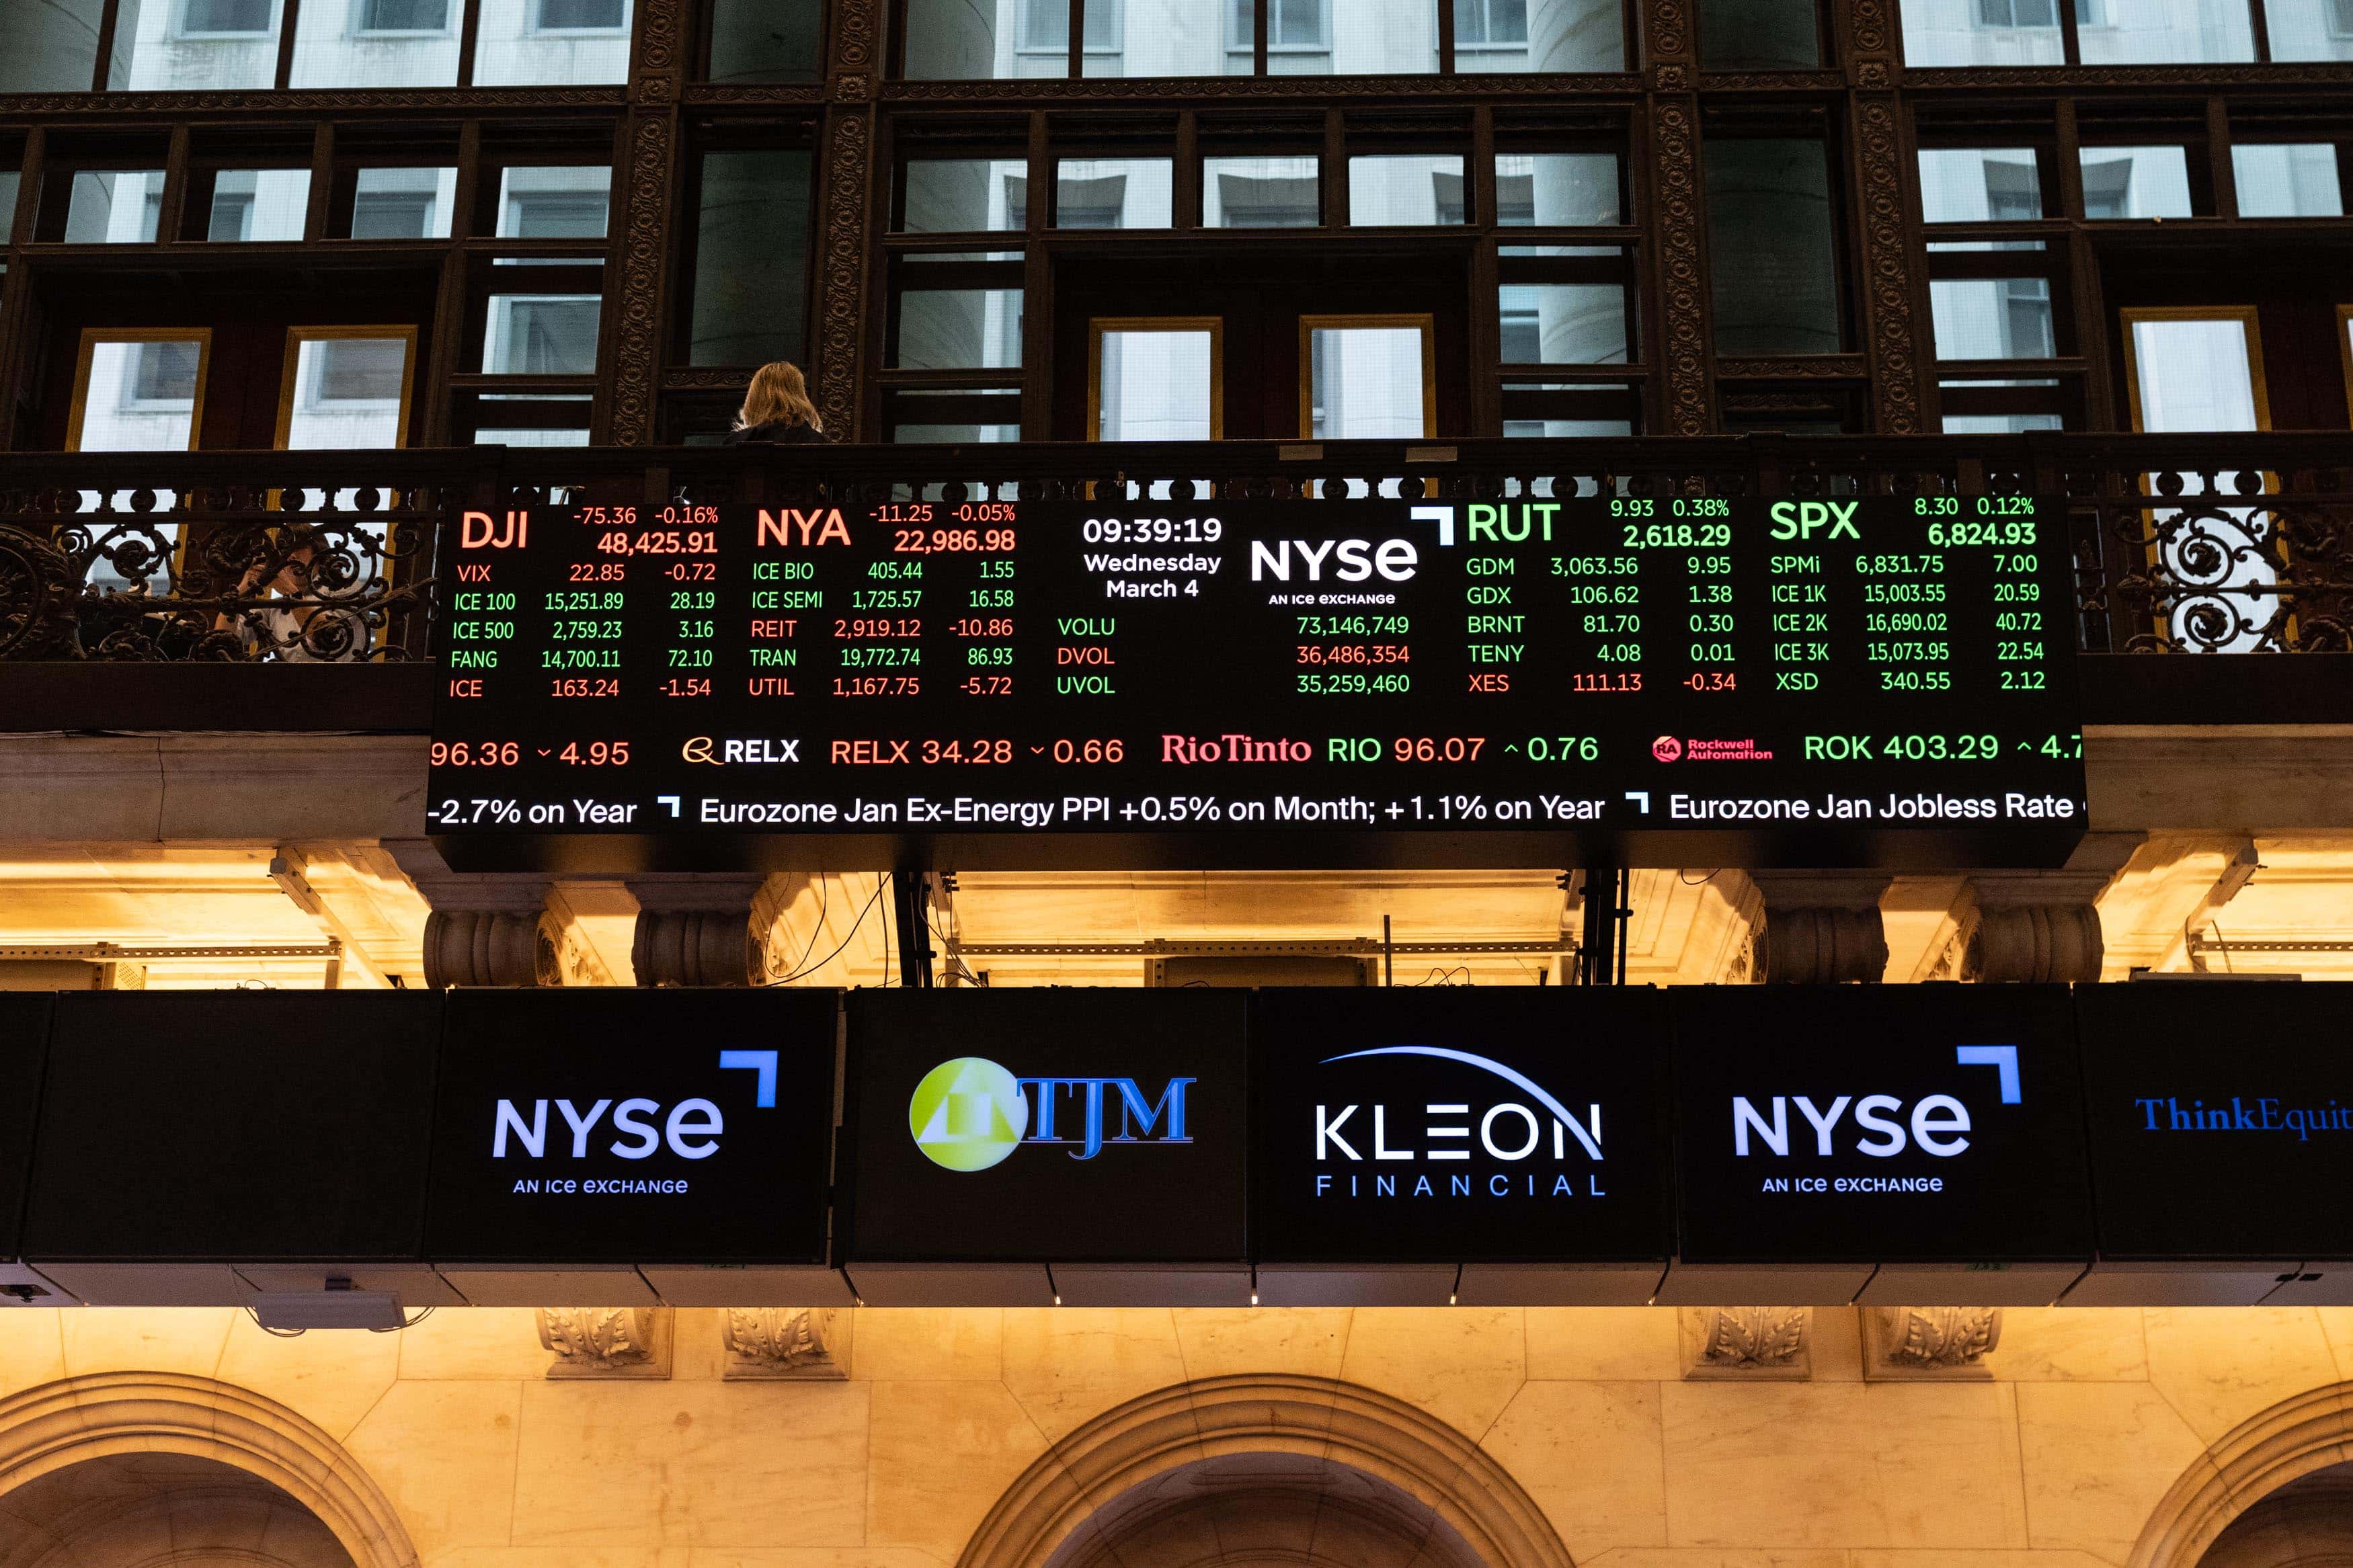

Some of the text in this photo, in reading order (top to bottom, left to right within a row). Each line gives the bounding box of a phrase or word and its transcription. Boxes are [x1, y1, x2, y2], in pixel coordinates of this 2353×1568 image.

[574, 507, 718, 524] -75.36 -0.16%
[870, 504, 1015, 522] -11.25 -0.05%
[1611, 499, 1729, 516] 9.93 0.38%
[1915, 497, 2034, 515] 8.30 0.12%
[462, 511, 527, 548] DJI
[758, 509, 851, 546] NYA
[1084, 518, 1221, 542] 09:39:19
[1469, 504, 1560, 541] RUT
[1770, 501, 1860, 540] SPX
[598, 532, 717, 556] 48,425.91
[894, 530, 1015, 554] 22,986.98
[1624, 525, 1730, 549] 2,618.29
[1929, 523, 2036, 548] 6,824.93
[457, 563, 715, 581] VIX 22.85 -0.72
[754, 561, 1014, 579] ICE BIO 405.44 1.55
[1084, 553, 1221, 574] Wednesday
[1467, 556, 1730, 577] GDM 3,063.56 9.95
[1771, 554, 2037, 575] SPMi 6,831.75 7.00
[1107, 579, 1199, 597] March 4
[1468, 586, 1732, 604] GDX 106.62 1.38
[1773, 583, 2039, 604] ICE 1K 15,003.55 20.59
[455, 592, 715, 612] ICE 100 15,251.89 28.19
[753, 590, 1013, 610] ICE SEMI 1,725.57 16.58
[1269, 595, 1287, 604] AN
[454, 621, 713, 641] ICE 500 2,759.23 3.16
[752, 619, 1012, 639] REIT 2,919.12 -10.86
[1058, 616, 1408, 636] VOLU 73,146,749
[1468, 614, 1733, 632] BRNT 81.70 0.30
[1773, 613, 2041, 633] ICE 2K 16,690.02 40.72
[452, 650, 712, 669] FANG 14,700.11 72.10
[750, 648, 1012, 667] TRAN 19,772.74 86.93
[1058, 646, 1409, 665] DVOL 36,486,354
[1468, 644, 1734, 662] TENY 4.08 0.01
[1776, 643, 2044, 662] ICE 3K 15,073.95 22.54
[450, 679, 711, 697] ICE 163.24 -1.54
[750, 677, 1011, 697] UTIL 1,167.75 -5.72
[1058, 675, 1409, 694] UVOL 35,259,460
[1469, 673, 1736, 692] XES 111.13 -0.34
[1776, 671, 2045, 690] XSD 340.55 2.12
[431, 742, 629, 766] 96.36 4.95
[725, 740, 799, 762] RELX
[832, 739, 1123, 764] RELX 34.28 0.66
[1329, 737, 1597, 761] RIO 96.07 0.76
[1657, 745, 1677, 753] RA
[1688, 739, 1753, 749] Rockwell
[1805, 736, 1872, 759] ROK
[1884, 735, 1998, 759] 403.29
[1687, 750, 1773, 759] Automation
[428, 799, 637, 823] -2.7% on Year
[701, 795, 1605, 827] Eurozone Jan Ex-Energy PPI +0.5% on Month; +1.1% on Year
[1671, 793, 2073, 819] Eurozone Jan Jobless Rate
[1016, 1077, 1197, 1161] TJM
[1316, 1104, 1603, 1161] KLEON
[514, 1180, 539, 1192] AN
[1317, 1175, 1605, 1196] FINANCIAL
[1763, 1179, 1788, 1192] AN
